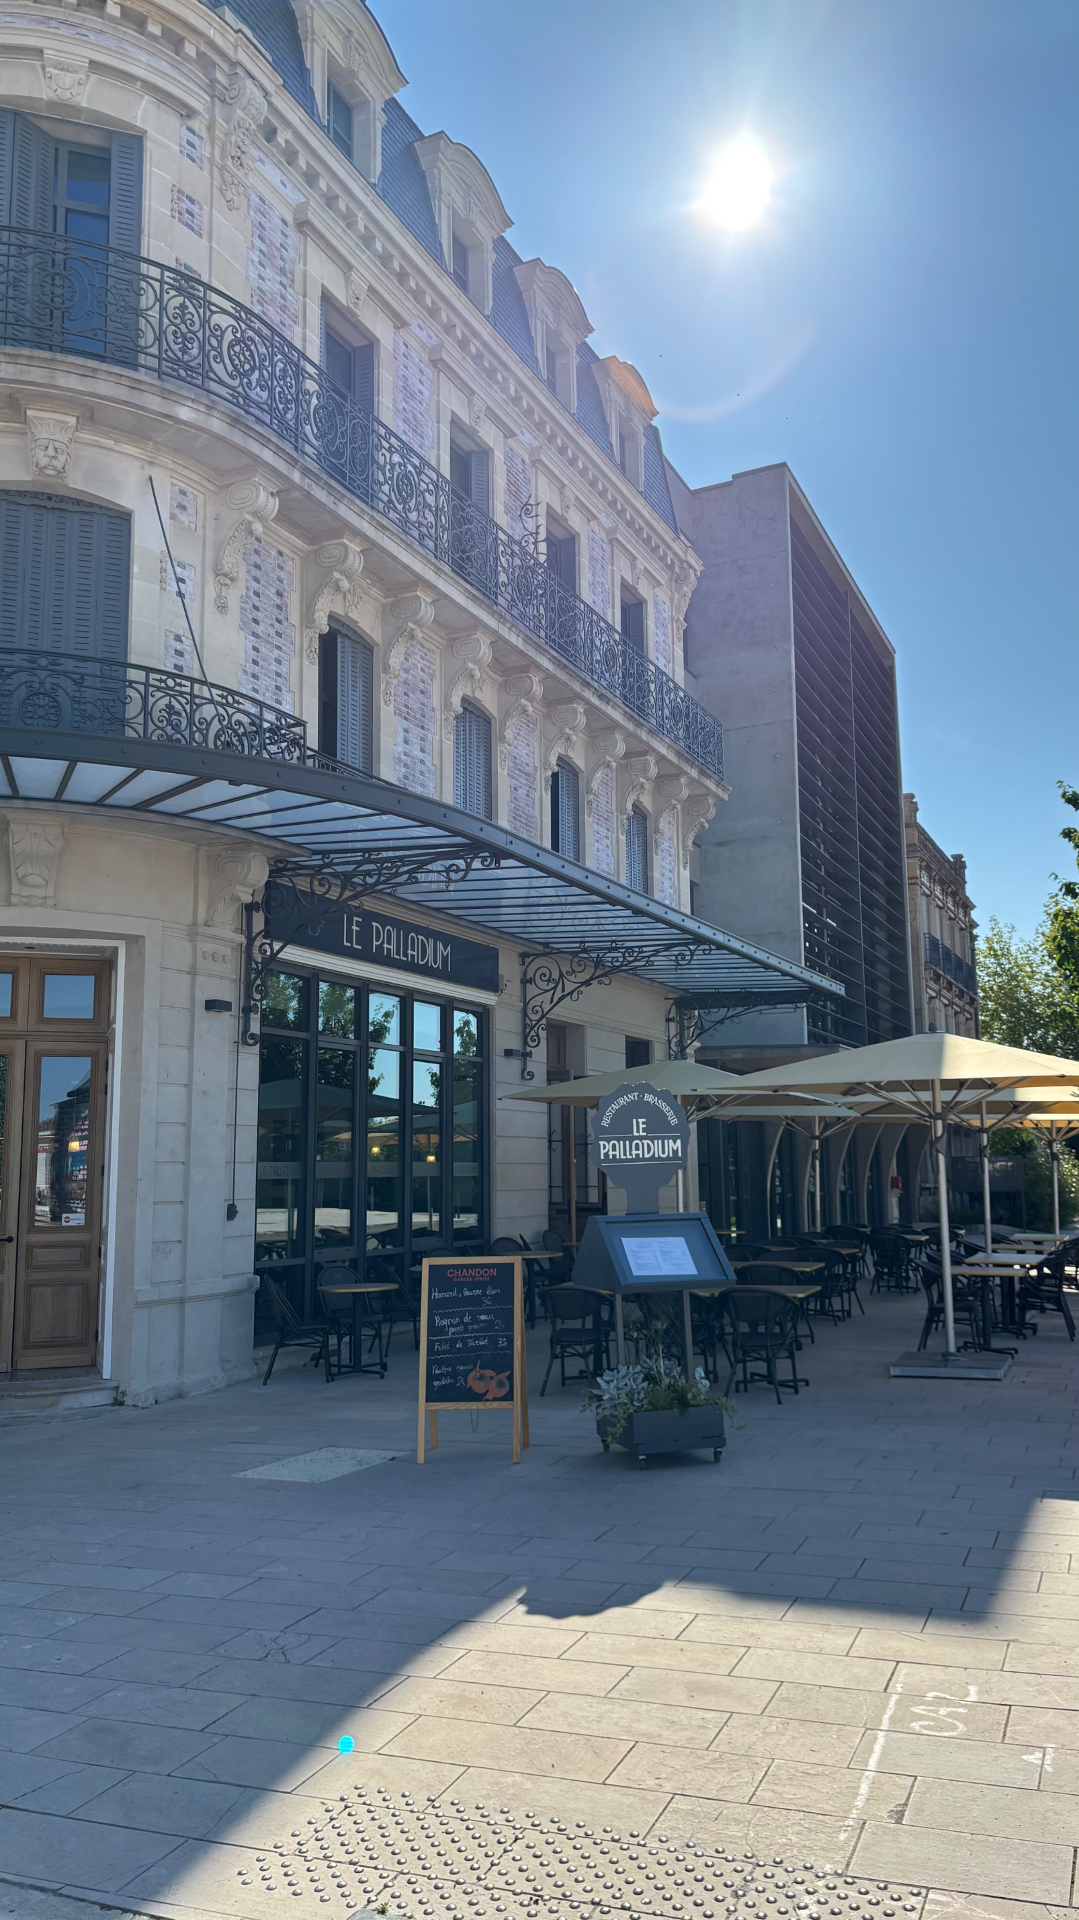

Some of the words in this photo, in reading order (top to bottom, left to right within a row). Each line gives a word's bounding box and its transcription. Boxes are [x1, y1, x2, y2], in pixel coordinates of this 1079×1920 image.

[343, 914, 362, 950] LE
[371, 921, 451, 972] PALLADIUM
[601, 1092, 639, 1128] RESTAURANT
[644, 1093, 679, 1126] BRASSERIE
[632, 1118, 647, 1136] LE
[599, 1138, 682, 1160] PALLADIUM
[447, 1268, 497, 1278] CHANDON
